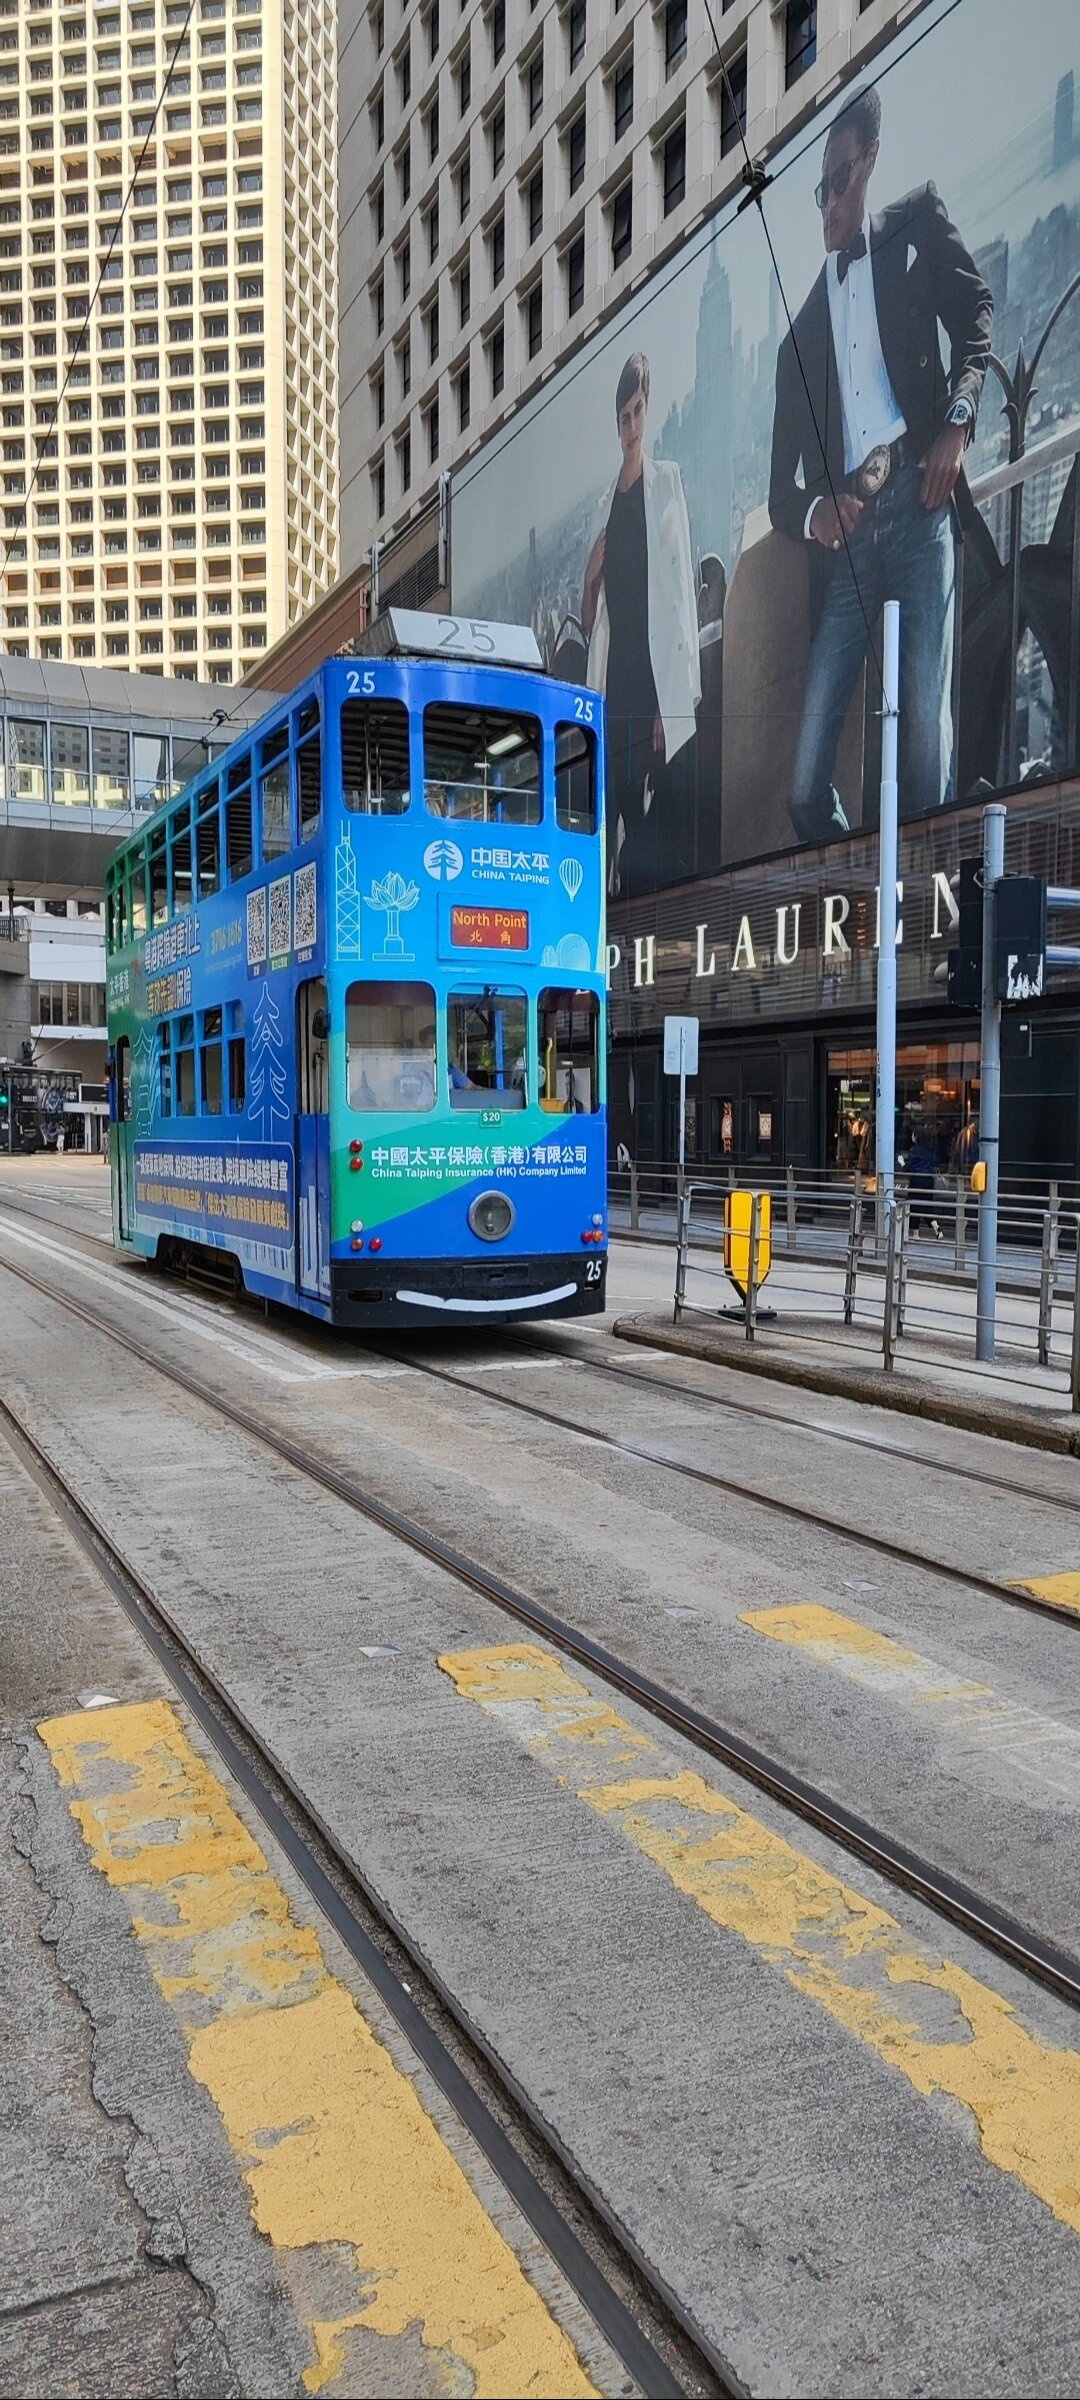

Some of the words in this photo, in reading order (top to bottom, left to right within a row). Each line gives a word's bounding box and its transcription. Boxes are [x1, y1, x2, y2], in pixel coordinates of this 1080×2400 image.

[437, 618, 496, 653] 25
[346, 670, 376, 694] 25
[573, 697, 594, 721] 25
[471, 847, 550, 871] 中国太平
[471, 869, 506, 880] CHINA
[508, 872, 550, 885] TAIPING
[453, 911, 490, 926] North
[494, 913, 527, 928] Point
[482, 1112, 501, 1123] $20
[371, 1168, 402, 1178] China
[405, 1168, 443, 1179] Taiping
[445, 1168, 494, 1177] Insurance
[496, 1167, 517, 1178] (HK)
[519, 1167, 559, 1178] Company
[560, 1166, 587, 1176] Limited
[586, 1259, 603, 1283] 25
